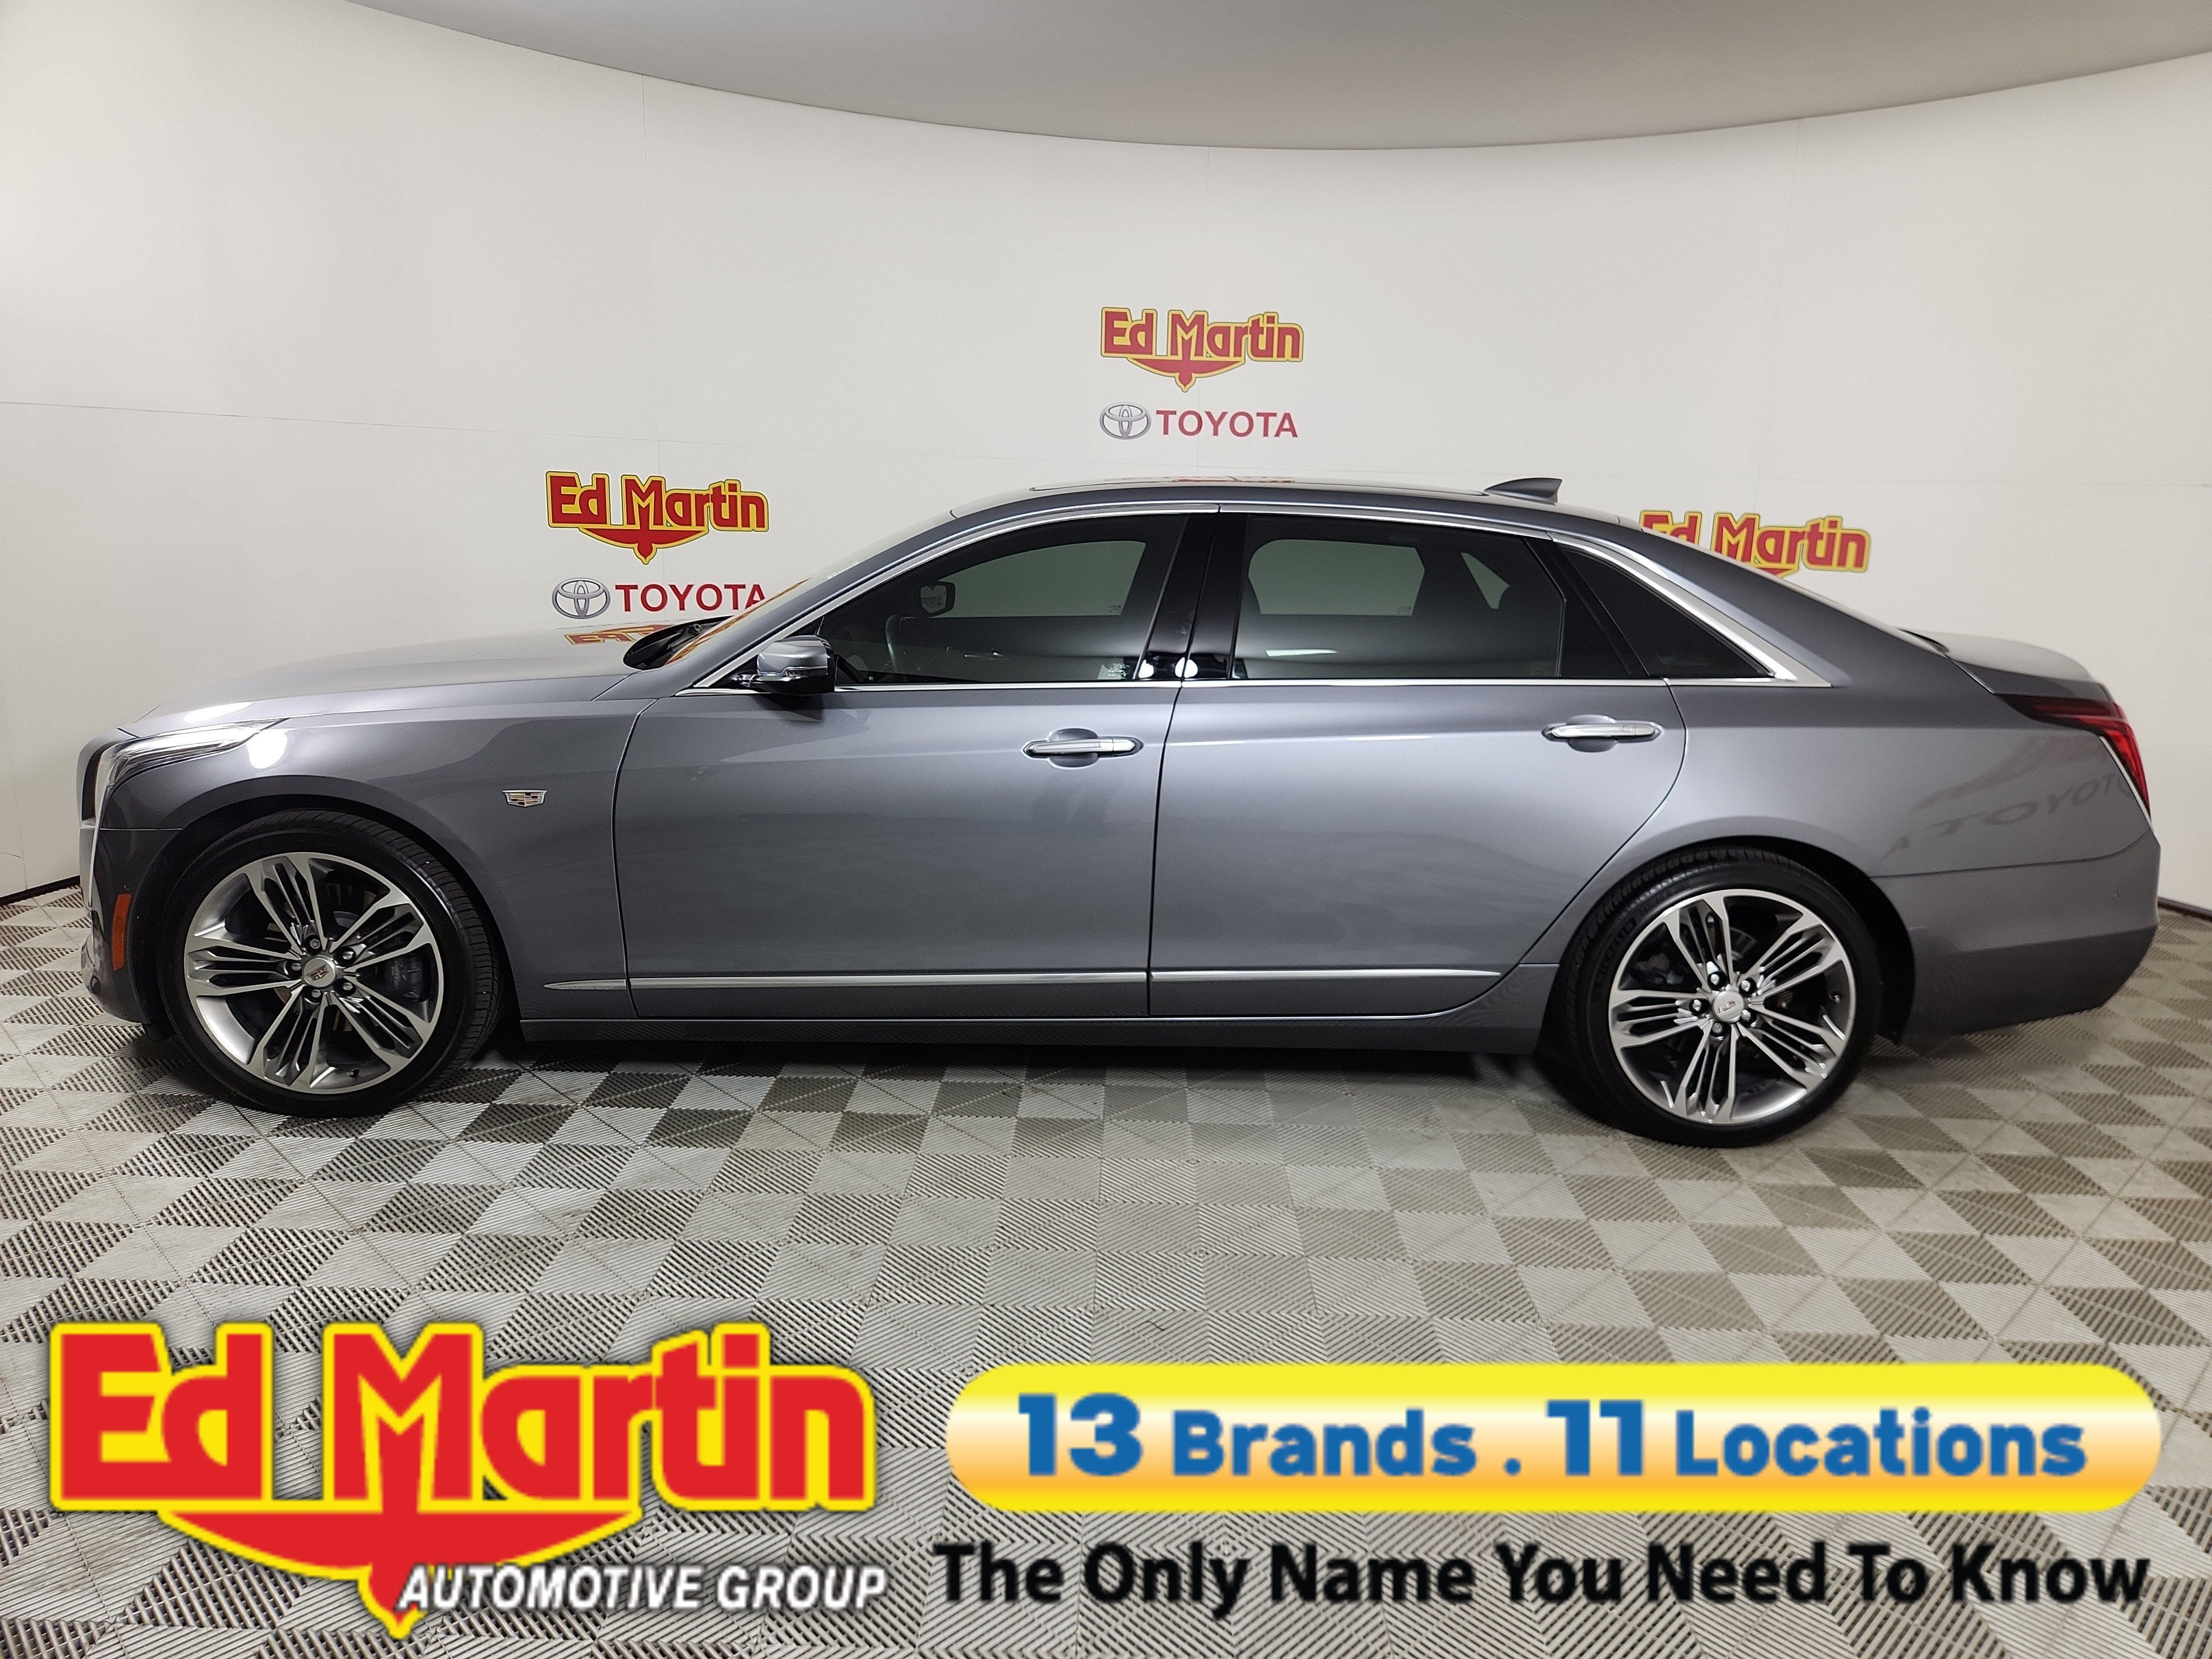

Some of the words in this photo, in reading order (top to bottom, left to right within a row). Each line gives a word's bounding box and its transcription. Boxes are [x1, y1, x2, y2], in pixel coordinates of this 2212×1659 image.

[1102, 310, 1155, 356] Ed
[1169, 312, 1302, 360] Martin
[1156, 409, 1298, 438] TOYOTA
[548, 473, 608, 526] Ed
[623, 476, 767, 530] Martin
[1713, 515, 1869, 569] Martin
[615, 583, 766, 612] TOYOTA
